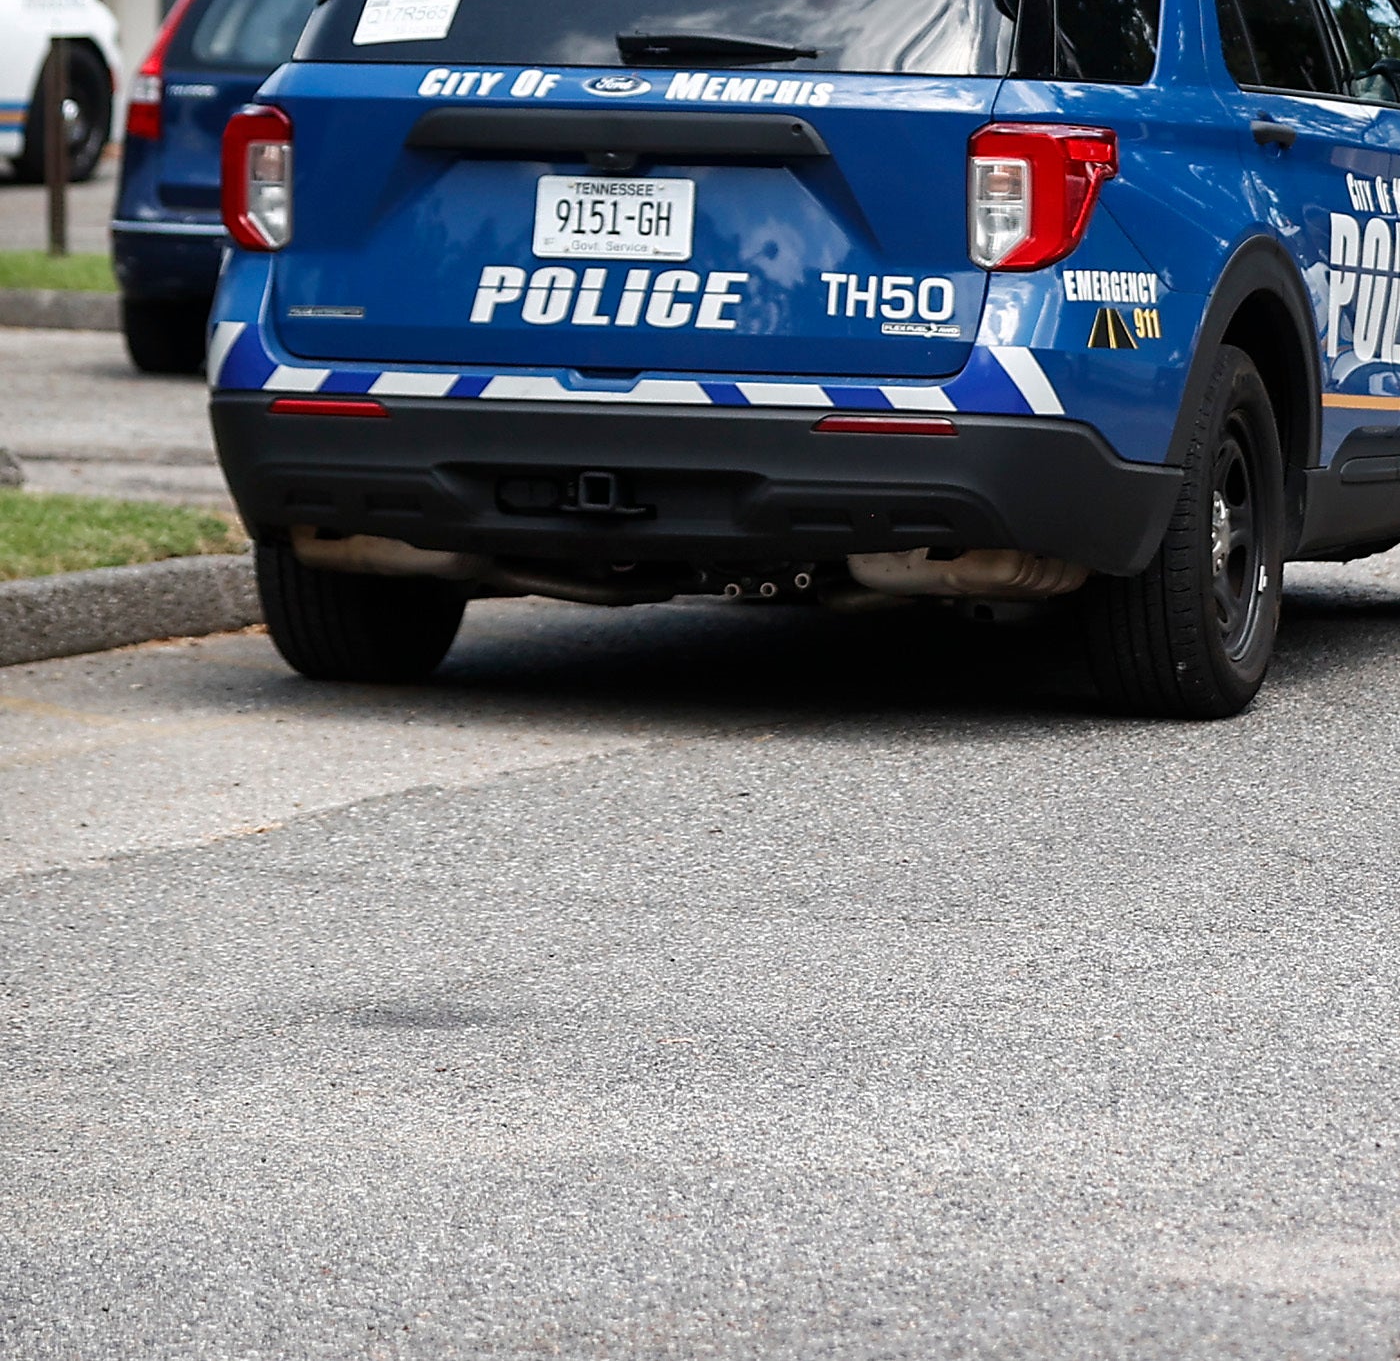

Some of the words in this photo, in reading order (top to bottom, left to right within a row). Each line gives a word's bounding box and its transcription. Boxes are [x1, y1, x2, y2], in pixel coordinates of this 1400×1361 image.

[418, 68, 504, 97] CITY
[509, 69, 562, 98] OF
[596, 76, 636, 92] Ford
[664, 72, 835, 107] MEMPHIS
[574, 182, 655, 196] TENNESSEE
[555, 199, 672, 237] 9151-GH
[605, 241, 649, 253] Service
[470, 266, 749, 330] POLICE
[820, 272, 955, 321] TH50
[1062, 270, 1158, 304] EMERGENCY
[1133, 307, 1161, 339] 911
